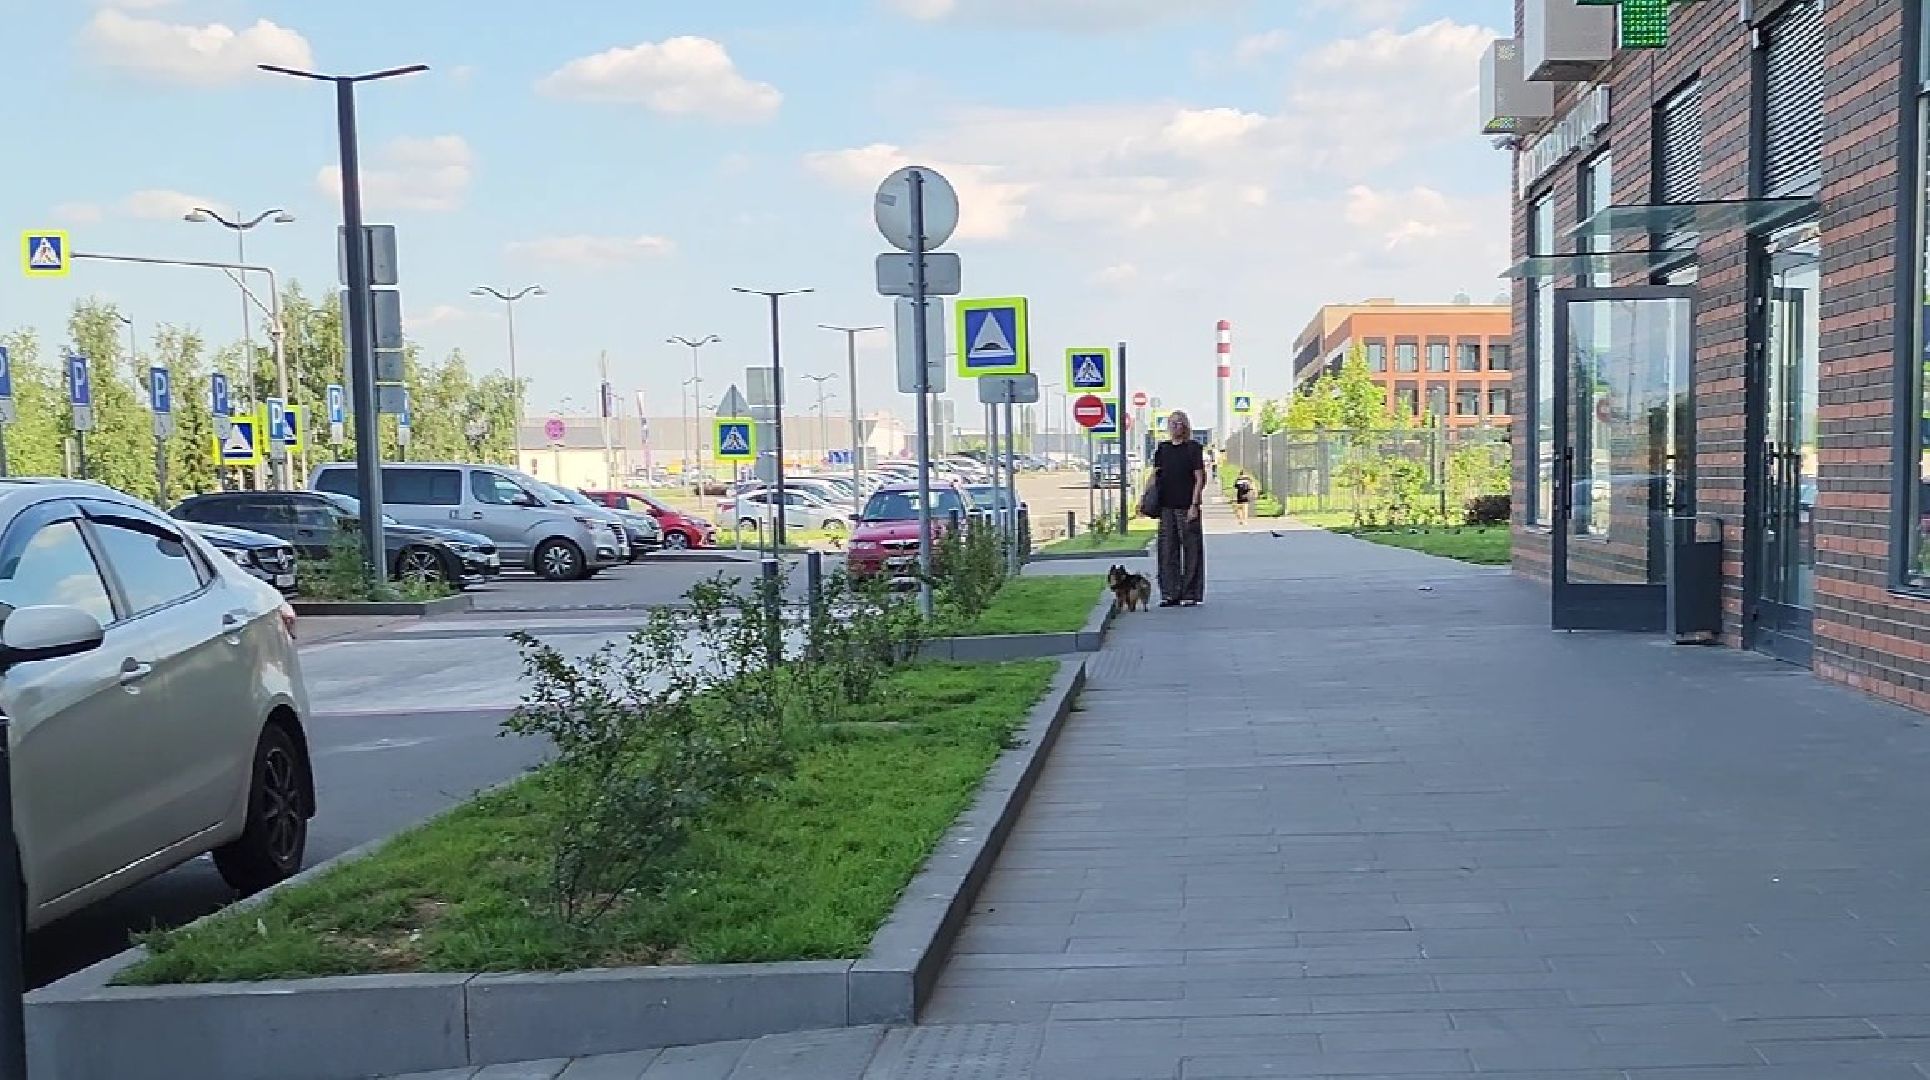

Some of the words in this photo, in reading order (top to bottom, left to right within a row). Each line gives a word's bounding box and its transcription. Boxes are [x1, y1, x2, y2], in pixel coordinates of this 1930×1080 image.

[73, 362, 86, 399] P
[154, 372, 167, 408] P
[216, 377, 226, 412] P
[272, 403, 281, 436] P
[331, 390, 340, 420] P
